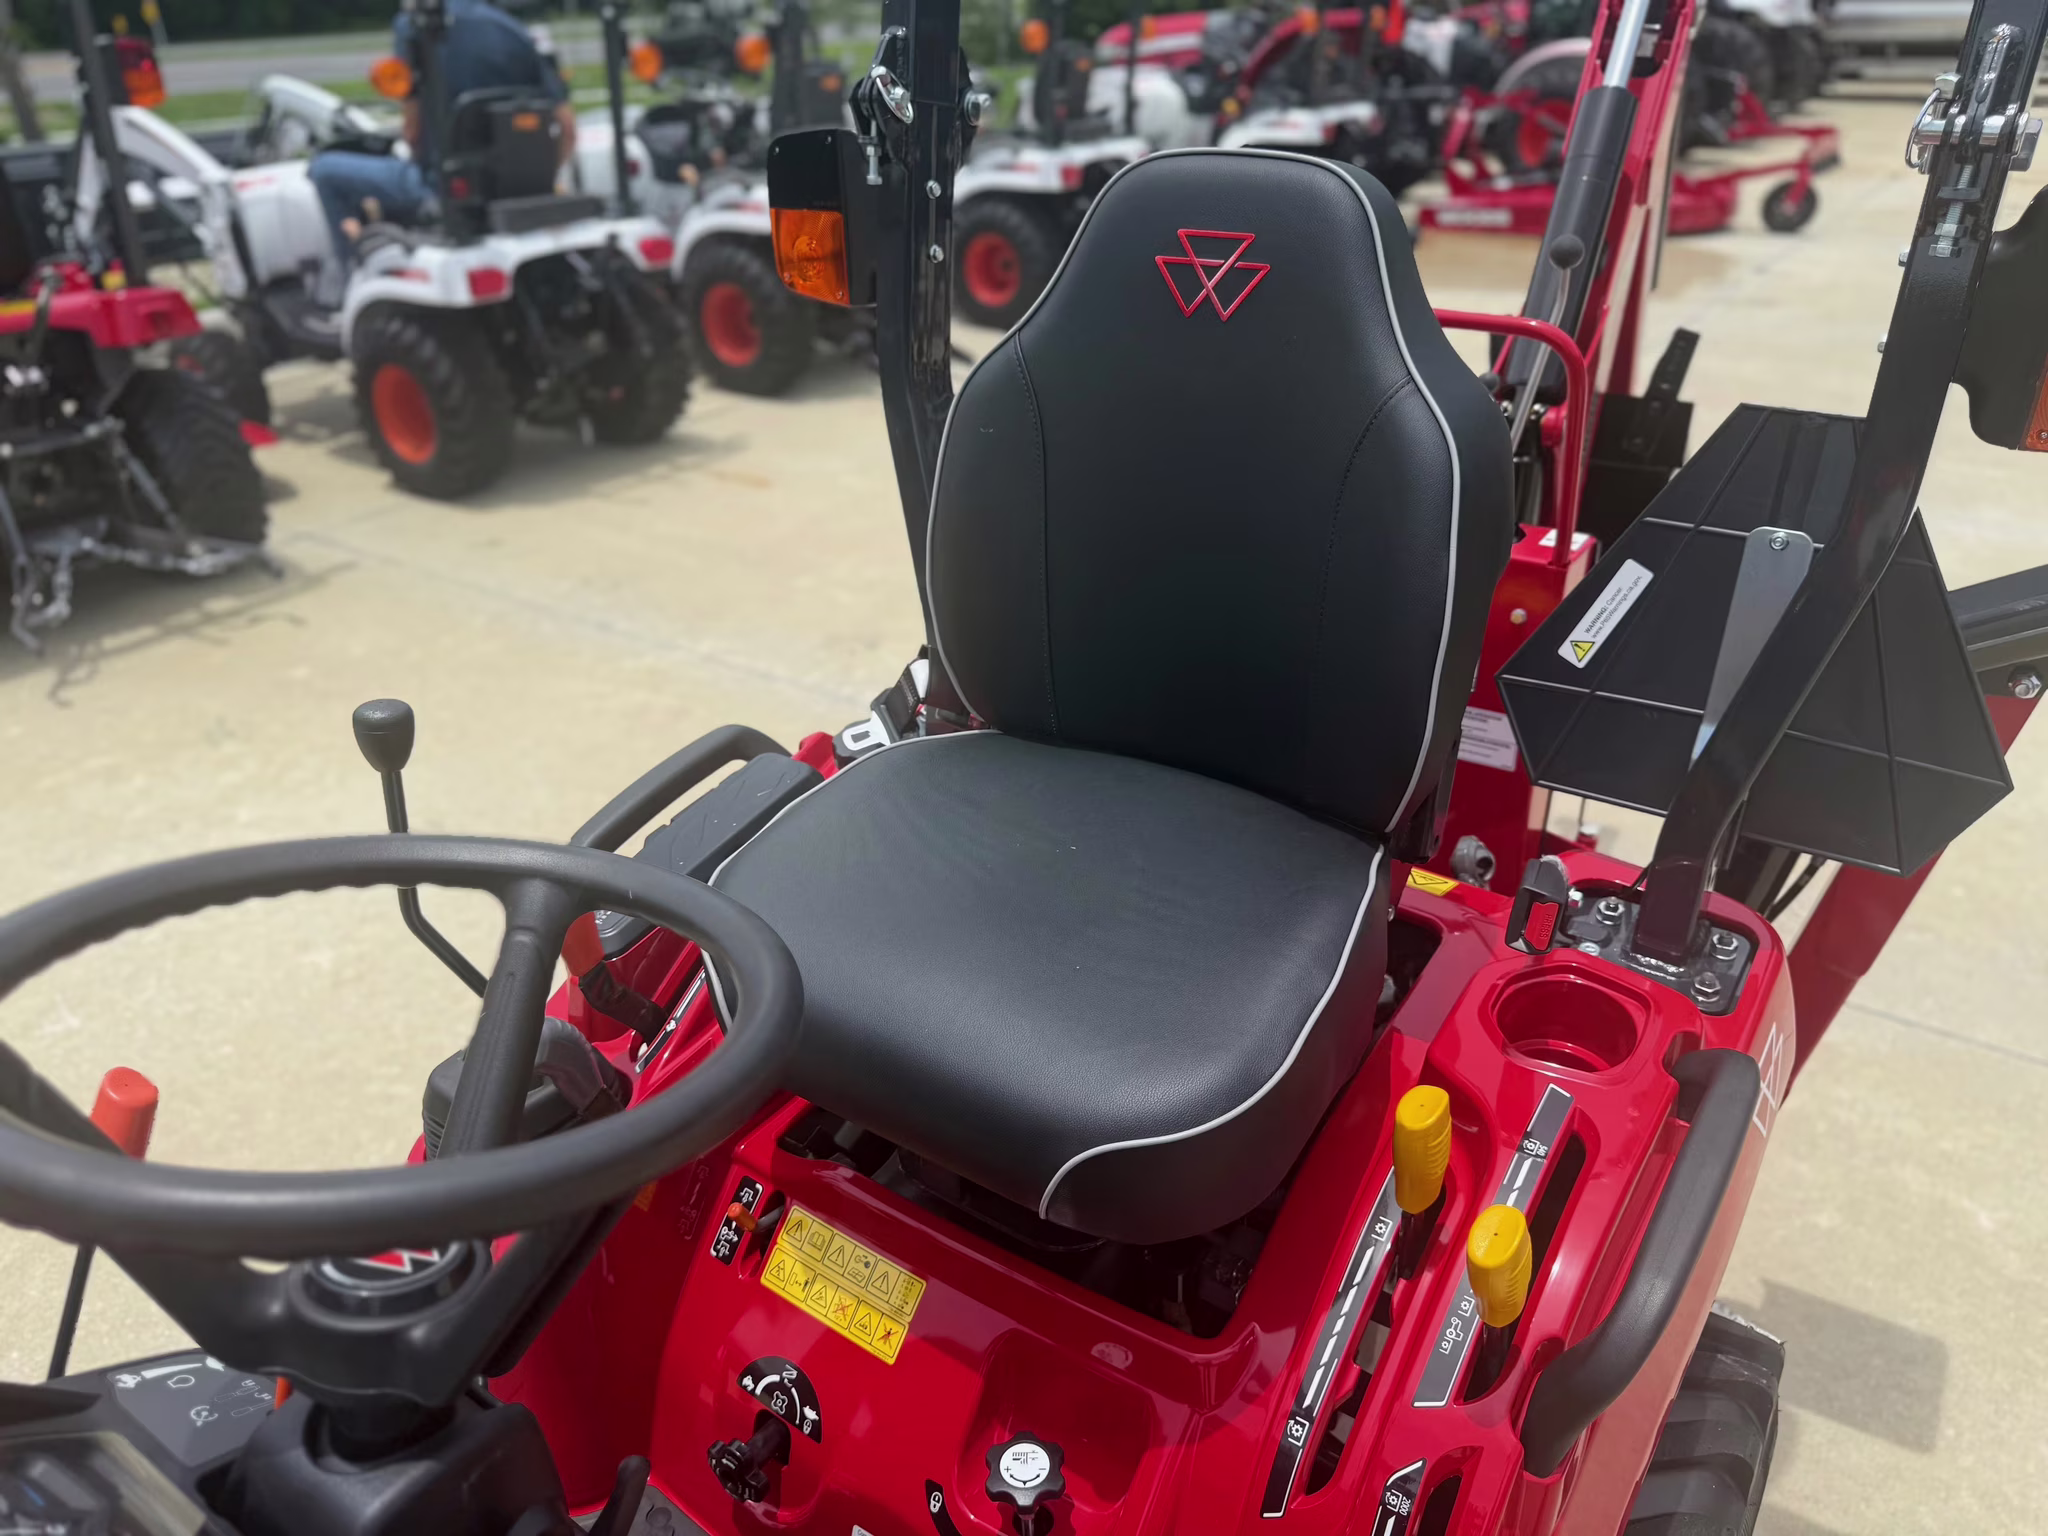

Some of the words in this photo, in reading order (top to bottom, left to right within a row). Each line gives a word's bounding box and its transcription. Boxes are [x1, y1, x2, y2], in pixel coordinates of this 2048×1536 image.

[1584, 605, 1609, 634] WARNING:
[1539, 913, 1552, 940] PRESS
[1399, 1496, 1411, 1516] 2000
